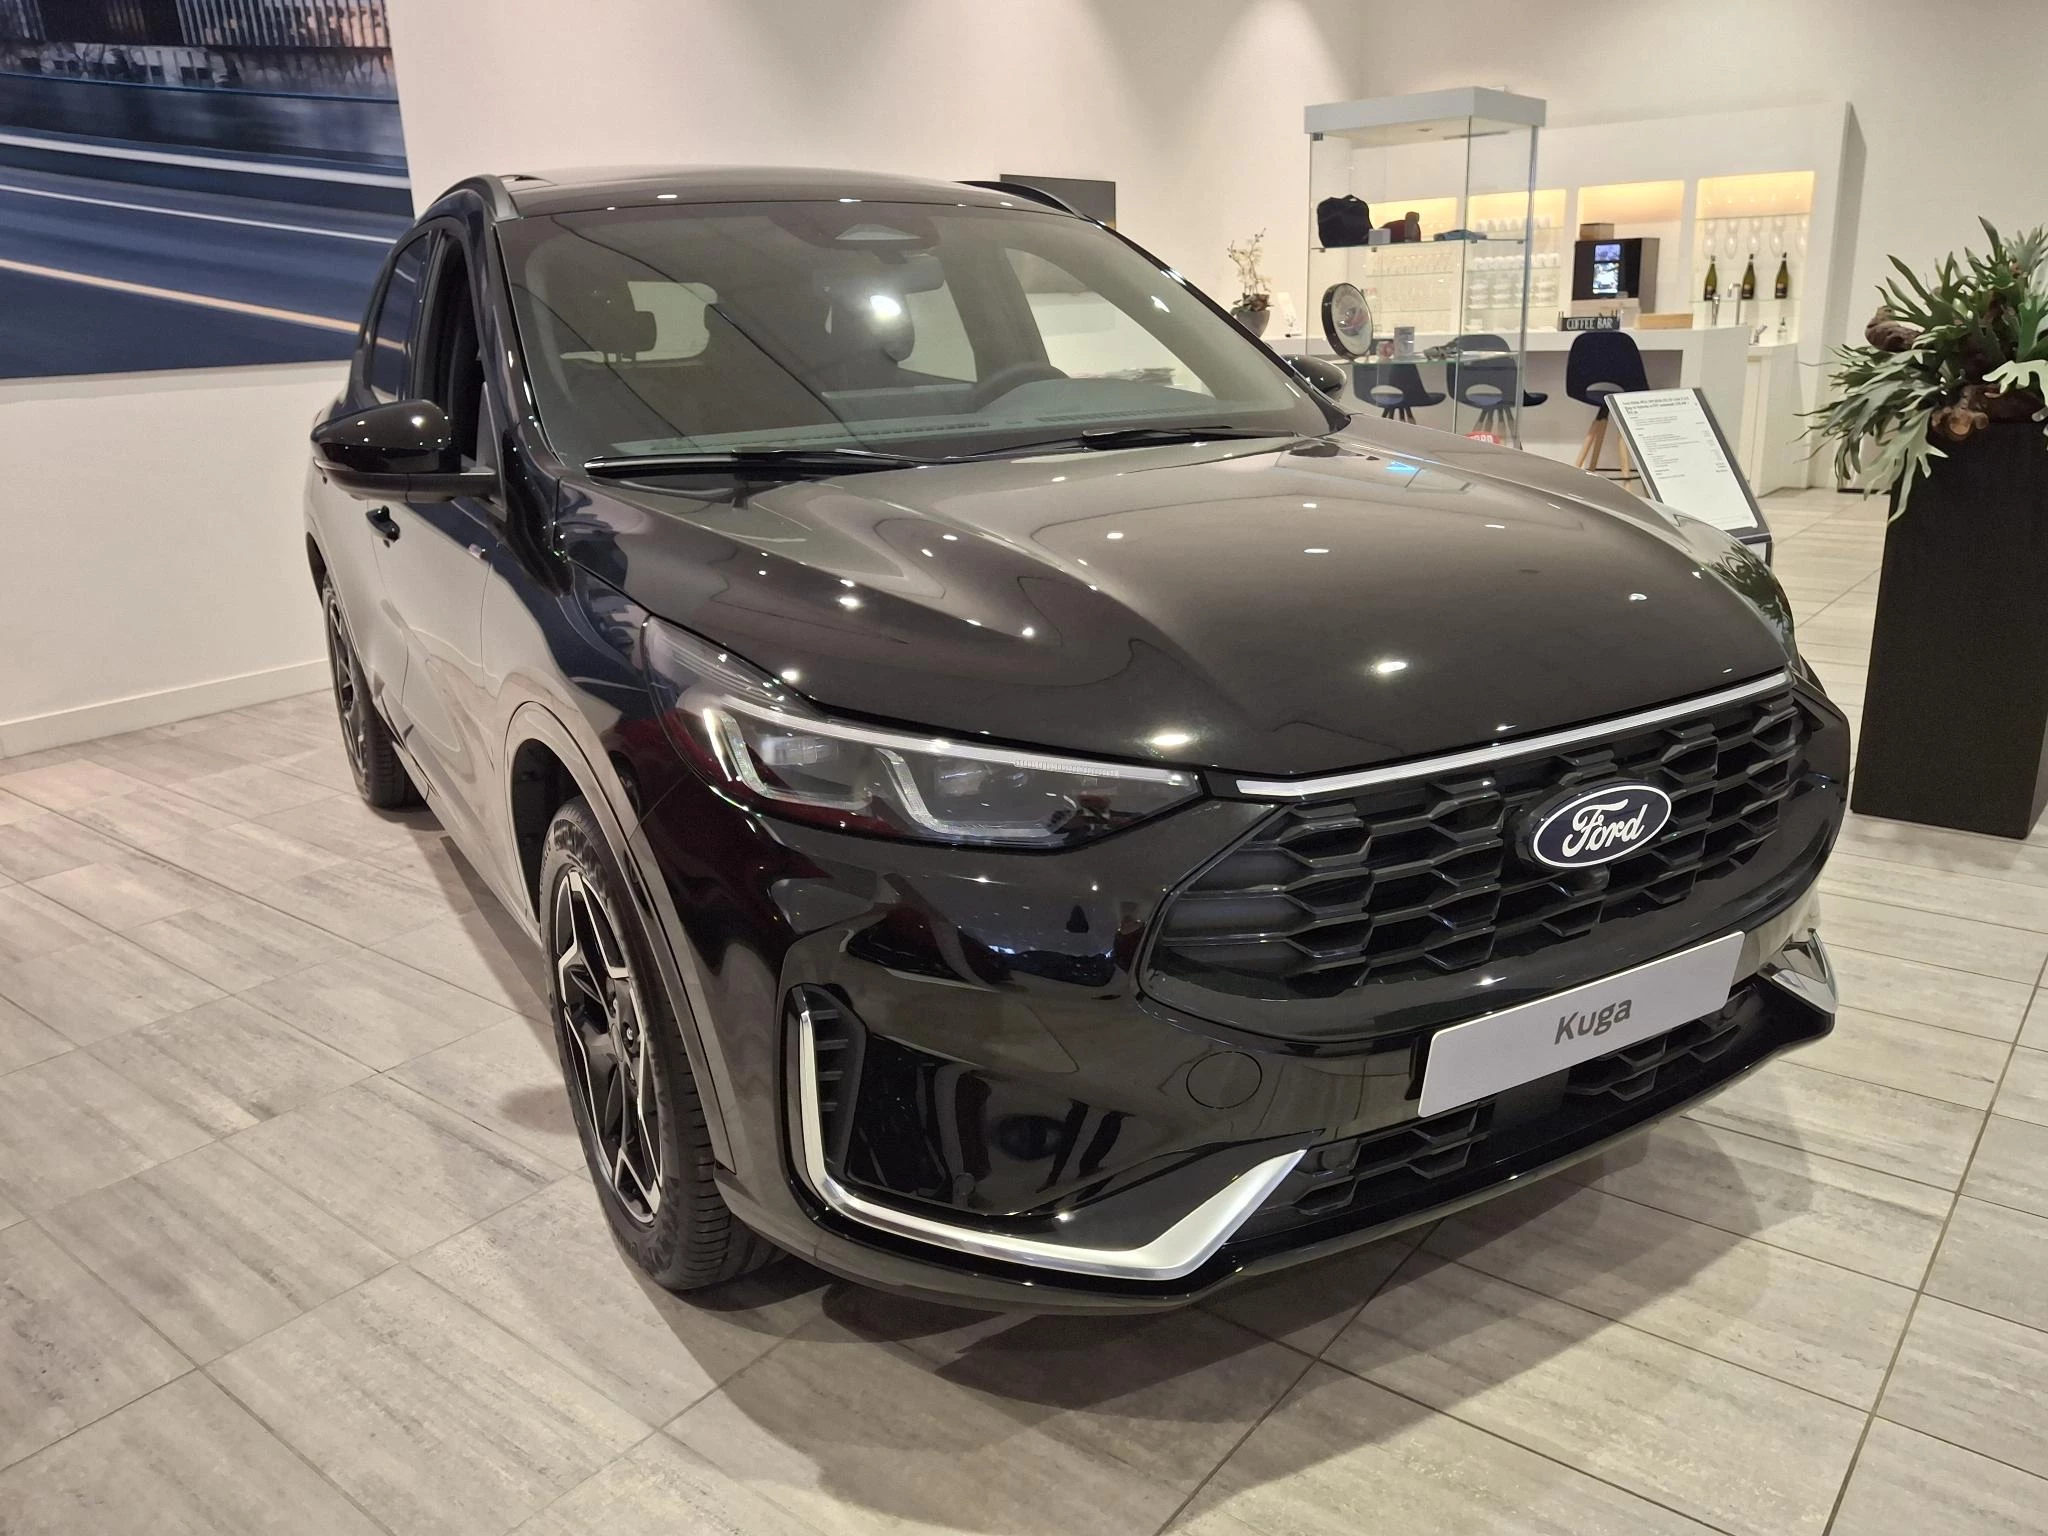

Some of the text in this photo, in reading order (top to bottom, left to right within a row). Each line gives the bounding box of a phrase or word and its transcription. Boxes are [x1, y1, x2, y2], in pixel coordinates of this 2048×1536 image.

[1567, 317, 1613, 330] COFFEE BAR
[1562, 799, 1647, 858] Ford
[1554, 997, 1632, 1045] Kuga
